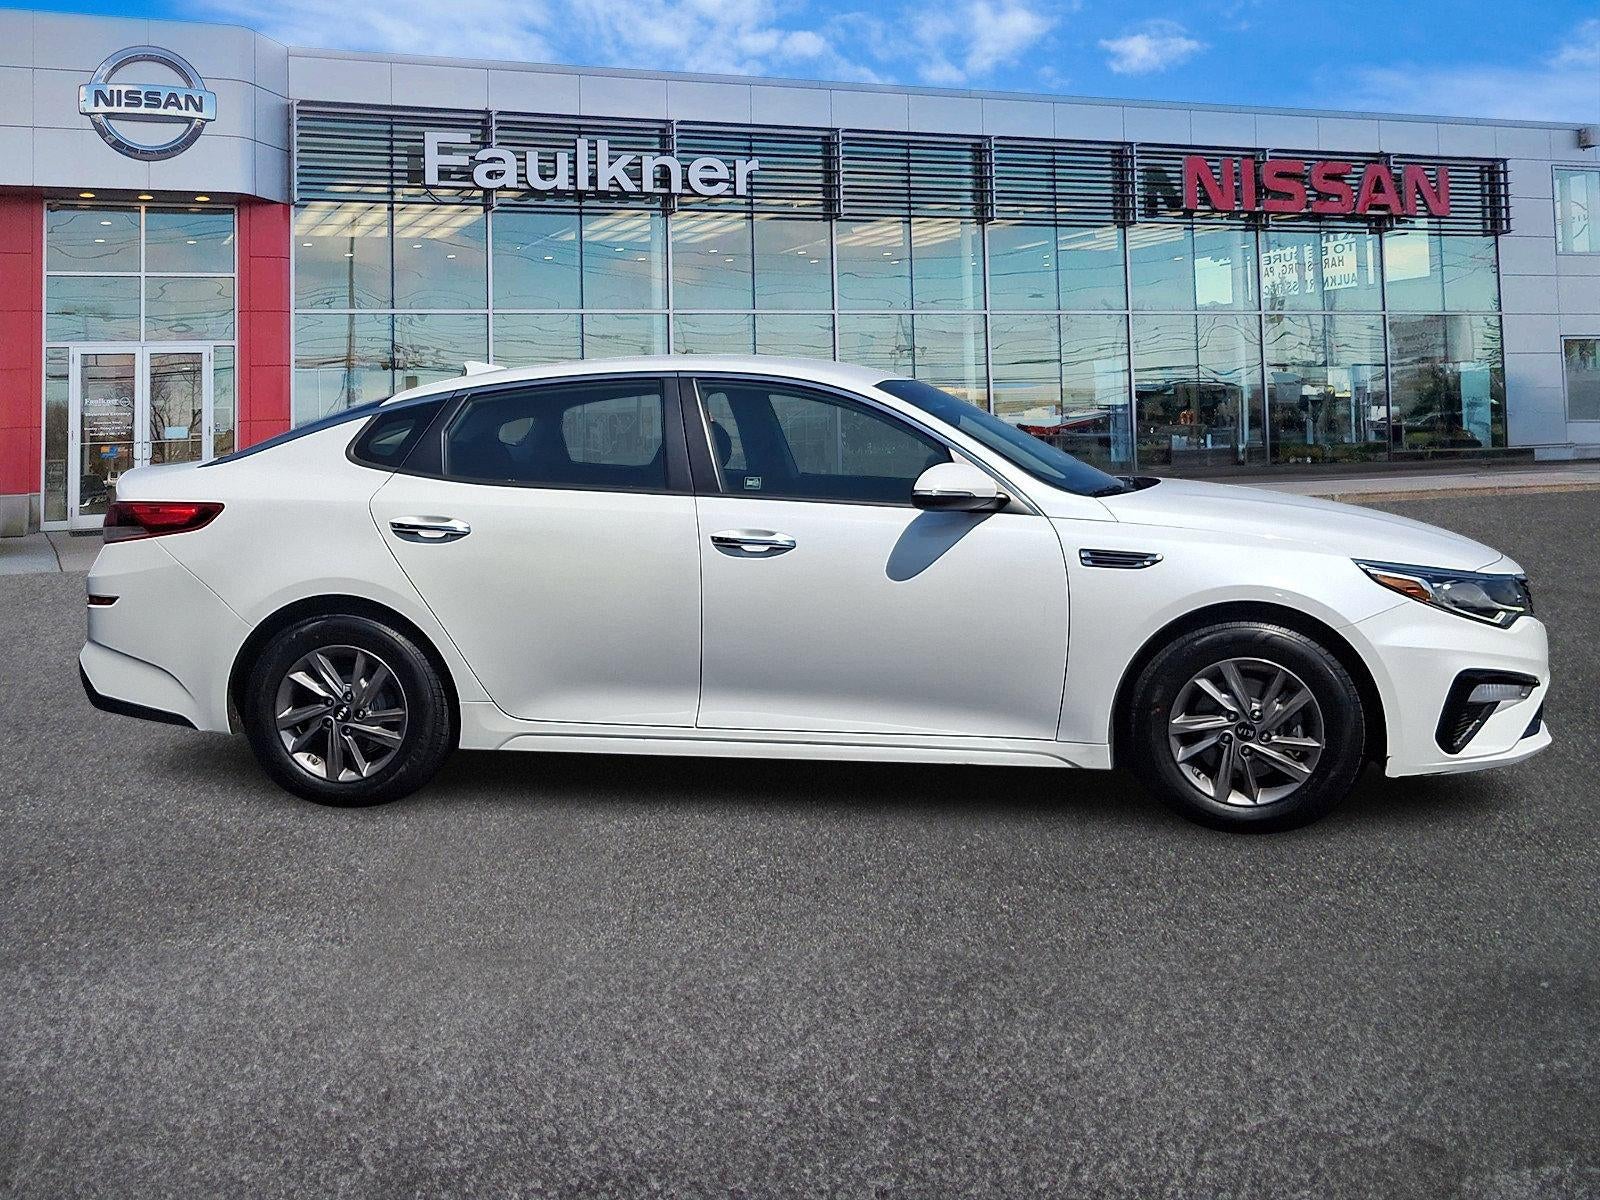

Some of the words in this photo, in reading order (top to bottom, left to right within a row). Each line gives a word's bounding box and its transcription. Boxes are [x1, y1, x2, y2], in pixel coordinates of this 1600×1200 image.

[93, 89, 204, 113] NISSAN
[423, 131, 760, 196] Faulkner
[1182, 155, 1451, 216] NISSAN
[1237, 727, 1255, 737] KIA
